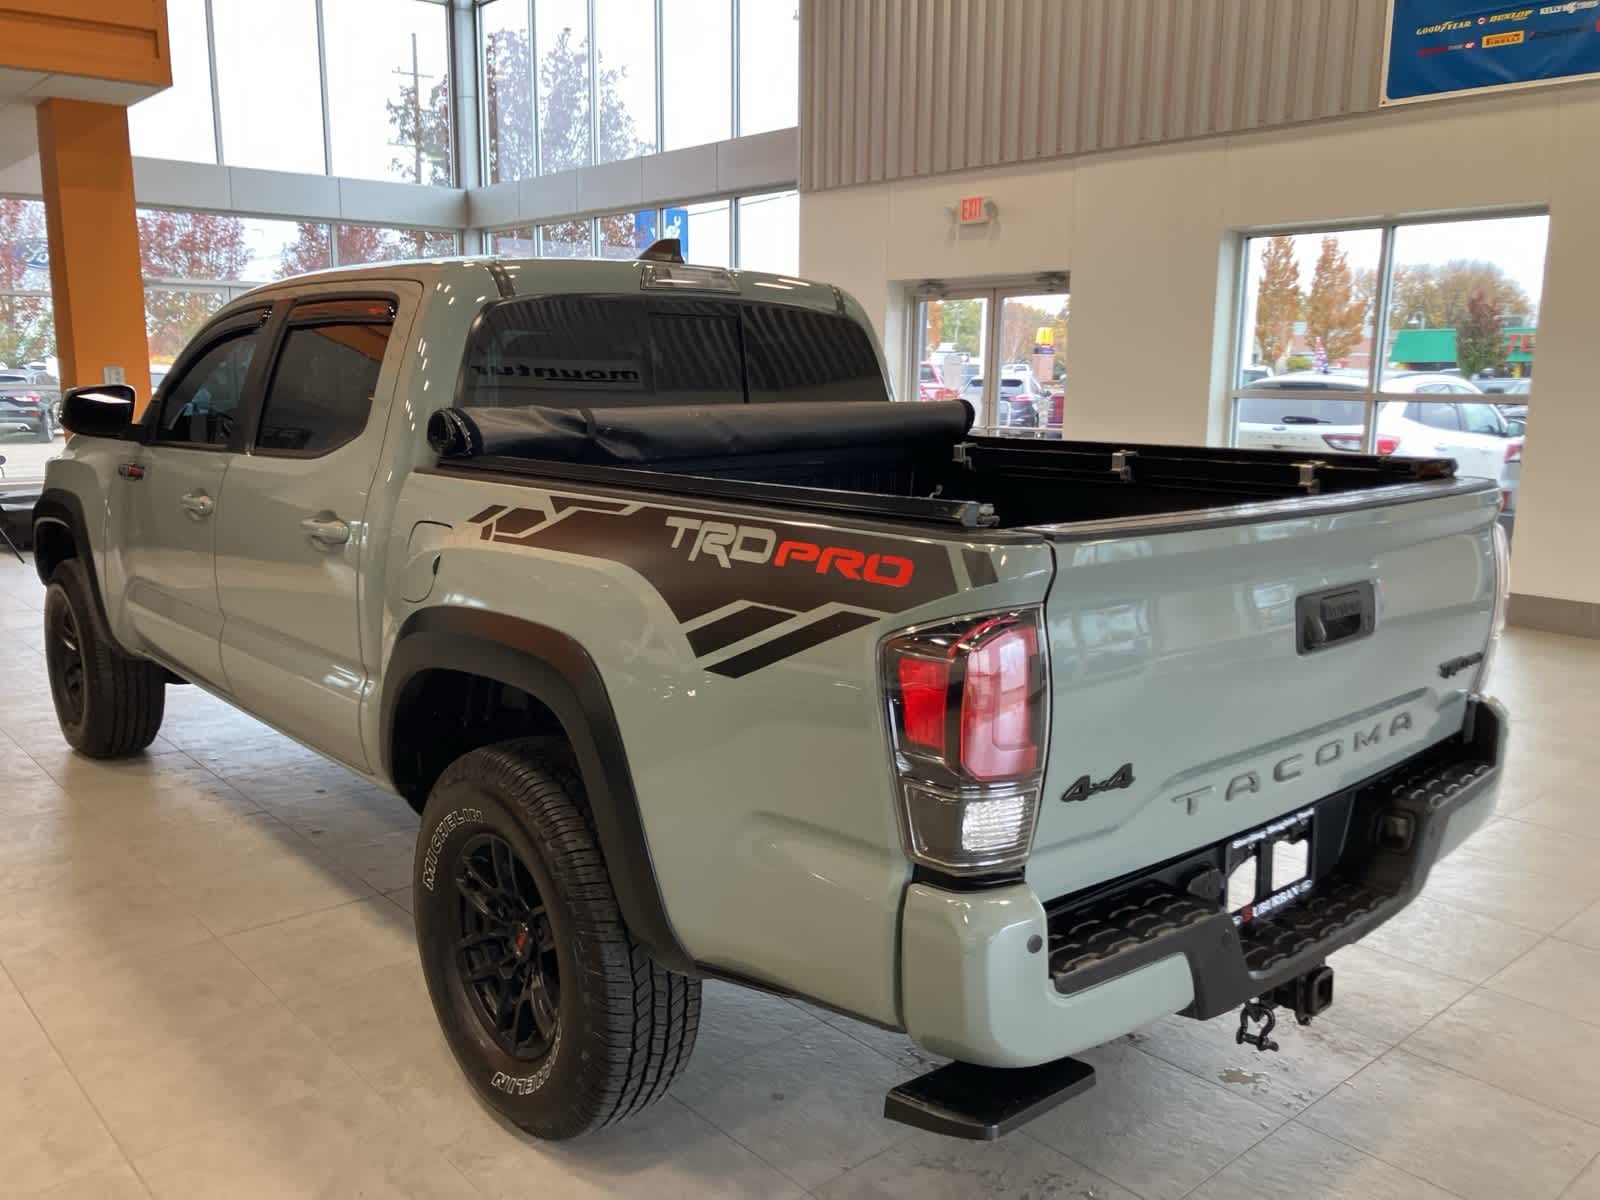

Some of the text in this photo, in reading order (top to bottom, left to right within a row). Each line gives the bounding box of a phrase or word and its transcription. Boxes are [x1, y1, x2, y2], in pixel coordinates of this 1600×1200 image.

[1416, 21, 1472, 36] GOODYEAR
[962, 197, 983, 221] EXIT
[665, 516, 915, 588] TRD PRO
[1171, 711, 1413, 816] TACOMA
[422, 808, 483, 891] MICHELIN
